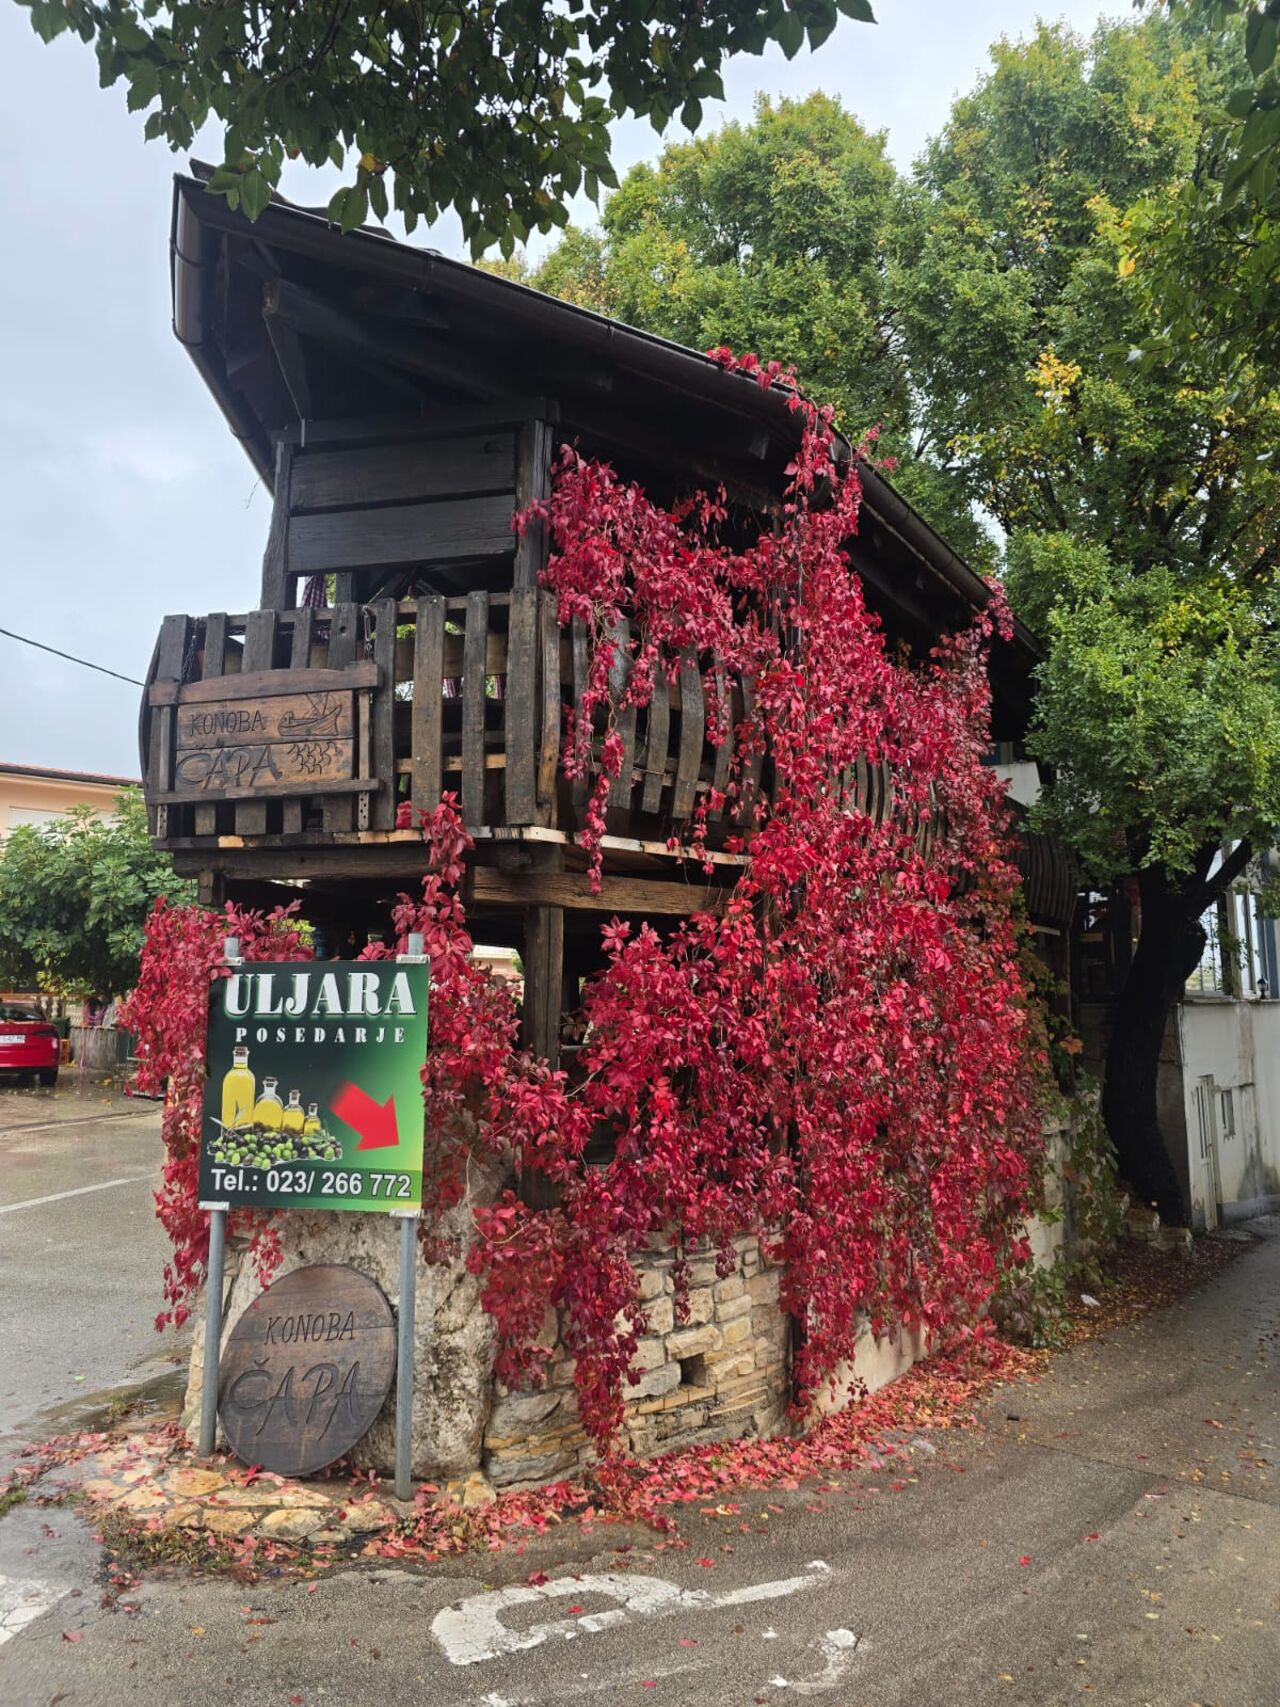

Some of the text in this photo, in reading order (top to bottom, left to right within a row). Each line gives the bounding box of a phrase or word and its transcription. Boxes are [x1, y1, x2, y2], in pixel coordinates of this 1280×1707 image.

[190, 710, 266, 737] KONOBA
[225, 972, 416, 1015] ULJARA
[235, 1027, 405, 1043] POSEDARJE
[211, 1169, 411, 1197] Tel.: 023/ 266 772
[264, 1311, 356, 1345] KONOBA
[229, 1357, 361, 1441] ČAPA
